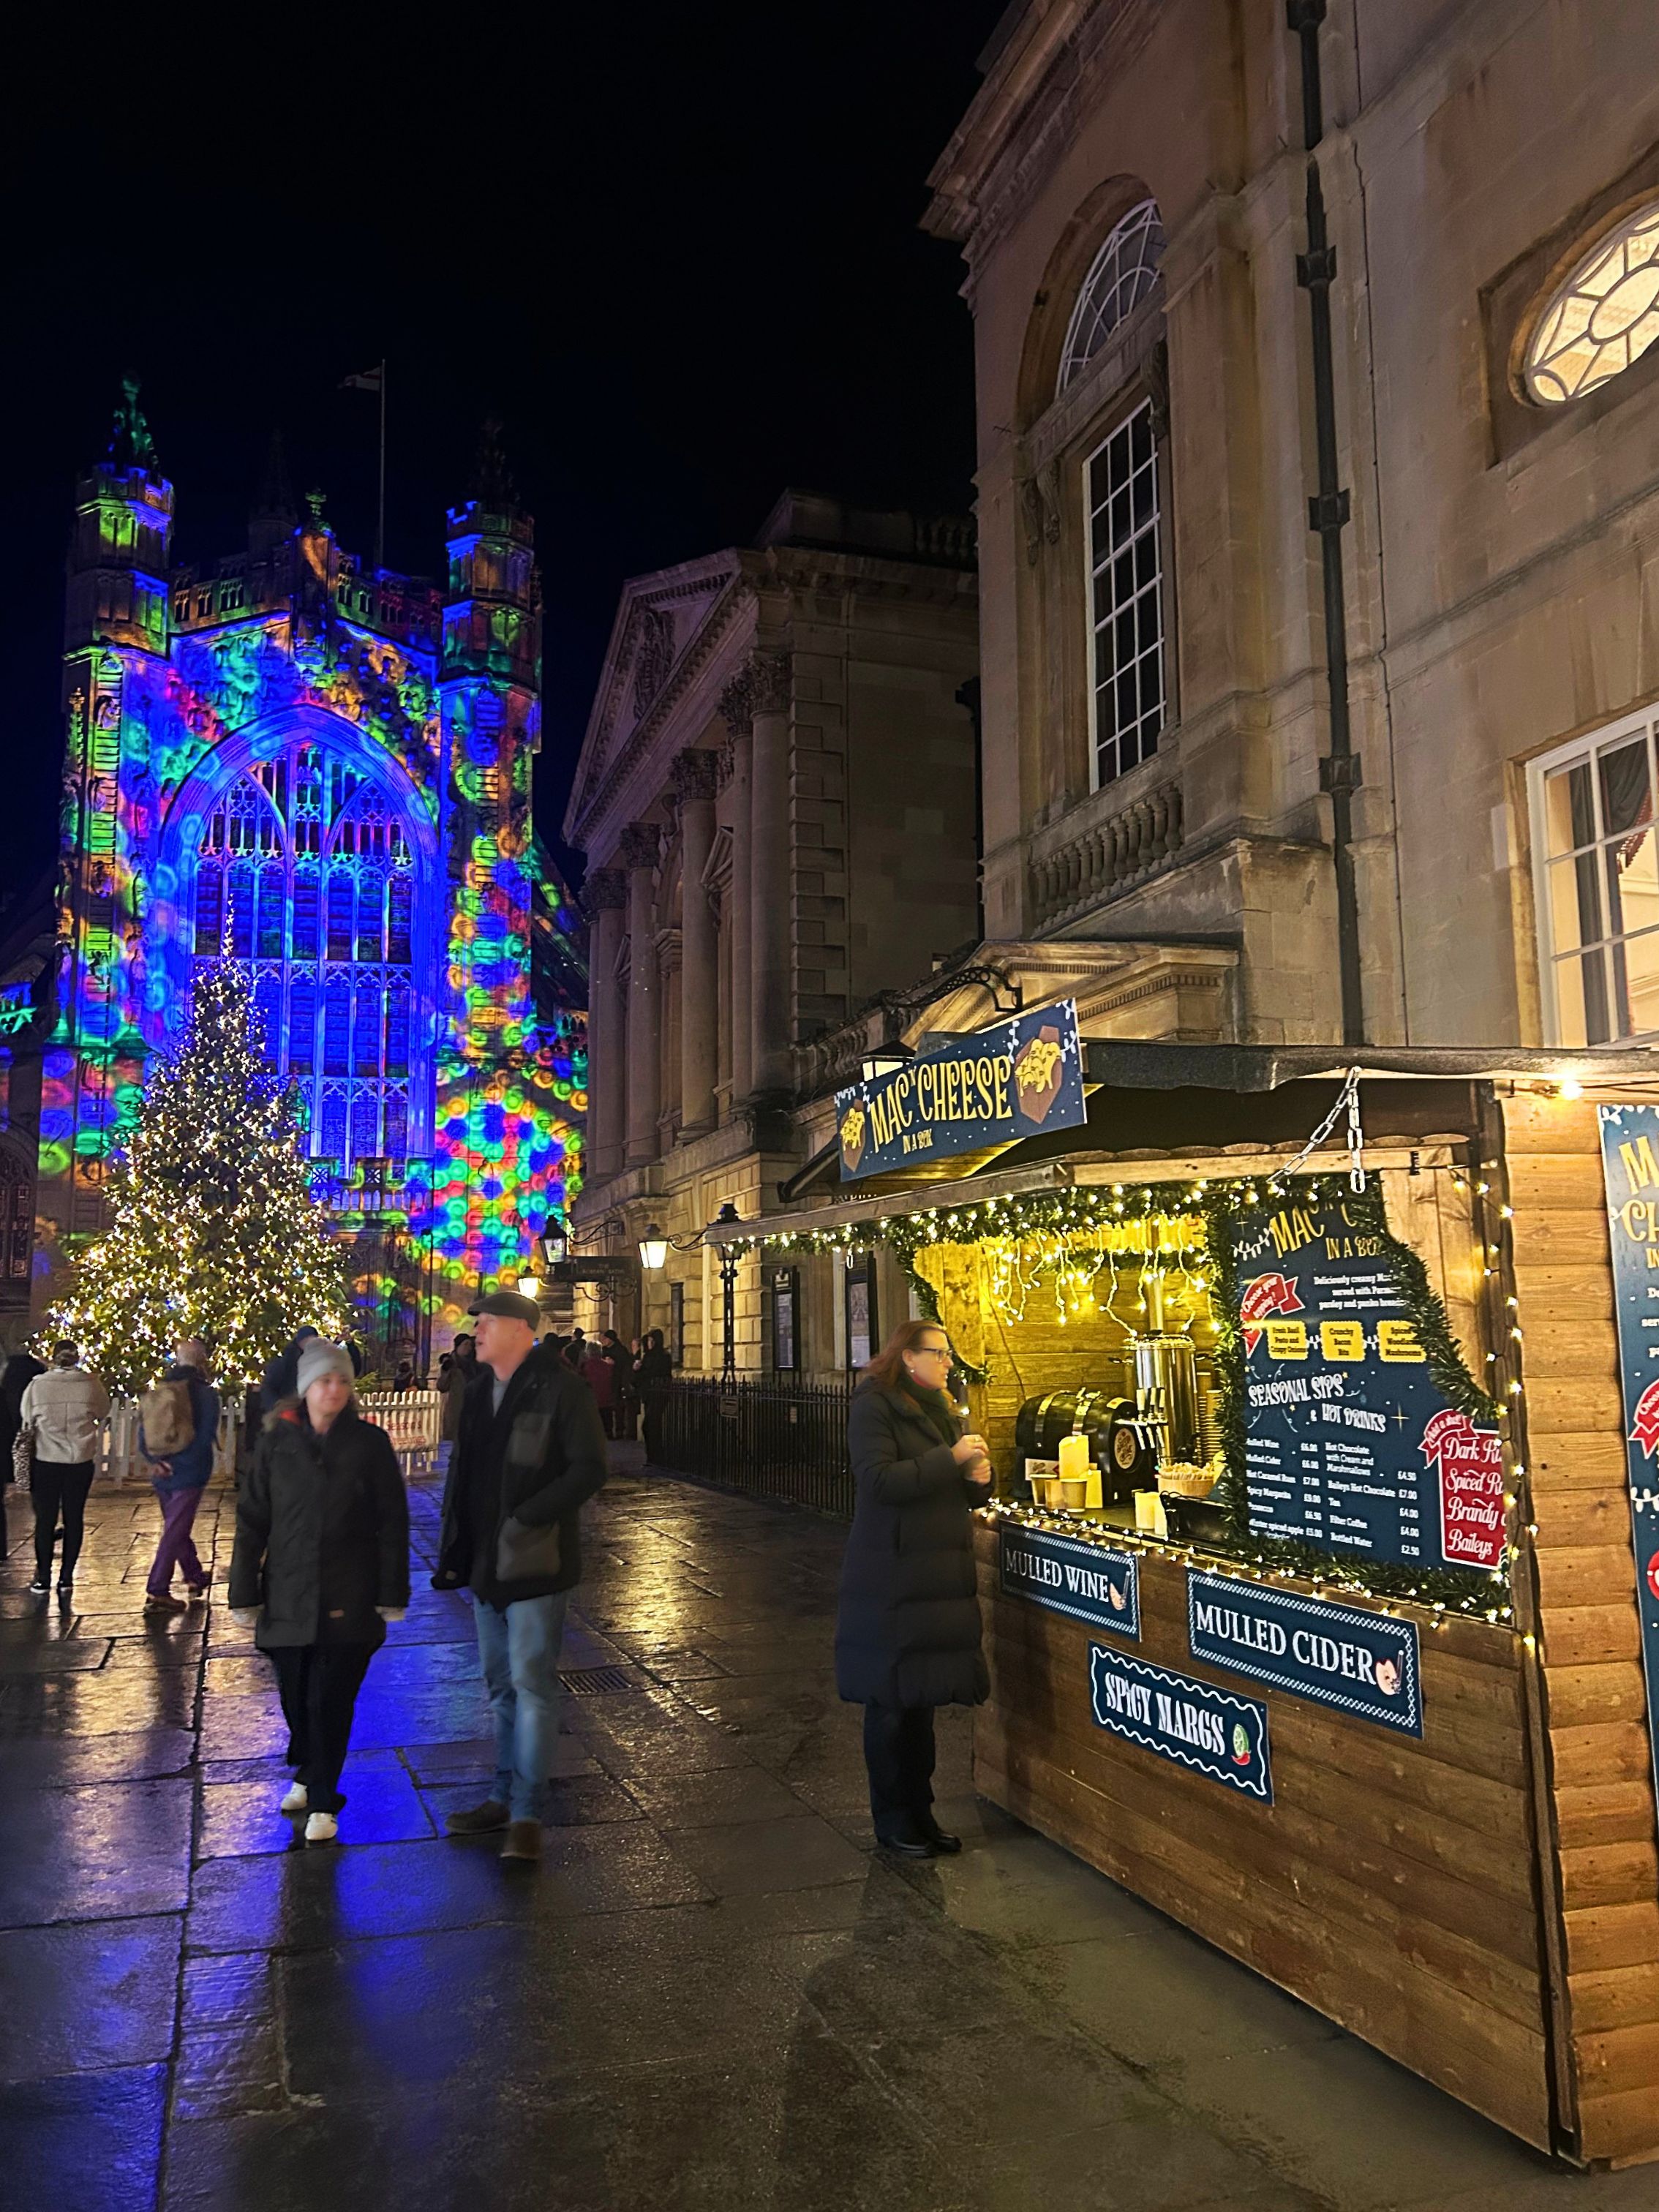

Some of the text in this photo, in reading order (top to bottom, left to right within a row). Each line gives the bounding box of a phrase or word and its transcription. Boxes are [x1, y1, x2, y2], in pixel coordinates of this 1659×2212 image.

[870, 1073, 913, 1154] MAC
[917, 1055, 1013, 1123] CHEESE
[911, 1134, 917, 1151] A
[1325, 1237, 1340, 1260] IN
[1343, 1237, 1353, 1258] A
[1355, 1287, 1372, 1295] with
[1344, 1299, 1357, 1307] and
[1329, 1328, 1354, 1336] Crunchy
[1248, 1374, 1344, 1407] SEASONAL SIPS
[1322, 1403, 1342, 1423] HOT
[1343, 1407, 1386, 1433] DRINKS
[1264, 1440, 1279, 1448] Wine
[1325, 1442, 1370, 1455] Hot Chocolate
[1442, 1437, 1480, 1460] Dark
[1265, 1456, 1281, 1465] Cider
[1340, 1454, 1361, 1464] Cream
[1361, 1457, 1374, 1466] and
[1303, 1476, 1320, 1487] £7.00
[1397, 1470, 1417, 1481] £4.50
[1445, 1467, 1486, 1493] Spiced
[1328, 1480, 1418, 1500] Baileys Hot Chocolate £7.00
[1328, 1497, 1419, 1519] Tea £4.00
[1445, 1496, 1499, 1531] Brandy
[1347, 1517, 1368, 1530] Coffee
[1400, 1526, 1420, 1538] £4.00
[1353, 1536, 1373, 1548] Water
[1401, 1544, 1420, 1556] £2.50
[1447, 1528, 1493, 1560] Baileys
[1006, 1548, 1110, 1603] MULLED WINE
[1195, 1600, 1377, 1685] MULLED CIDER
[1155, 1692, 1225, 1756] MARGS
